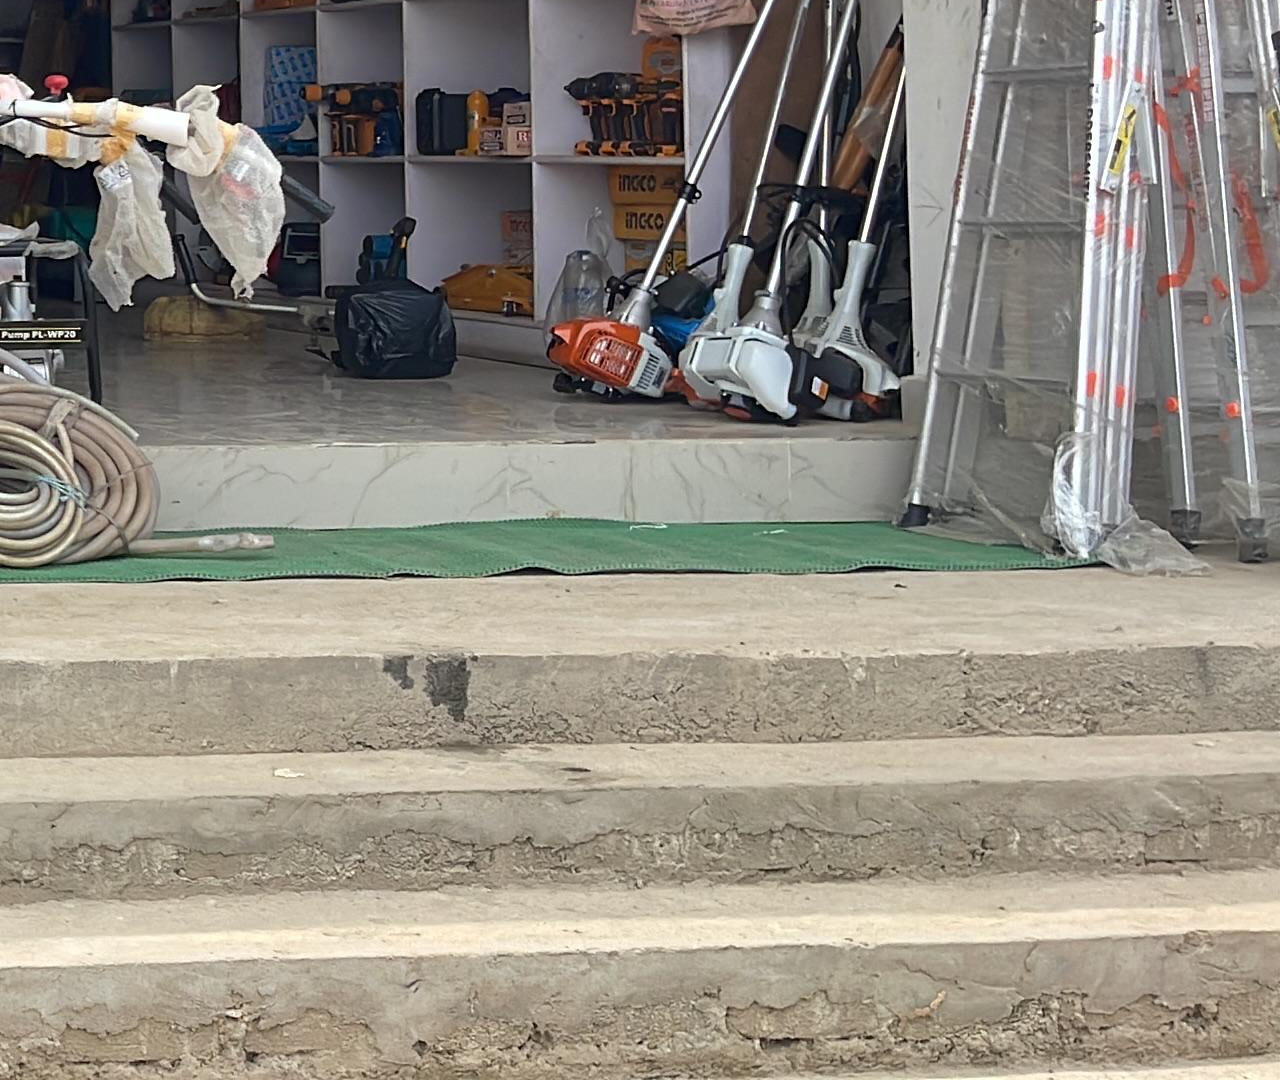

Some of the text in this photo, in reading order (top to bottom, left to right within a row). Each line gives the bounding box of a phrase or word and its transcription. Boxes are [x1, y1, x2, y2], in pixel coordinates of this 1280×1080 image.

[618, 174, 656, 192] INGCO
[625, 211, 664, 230] INGCO
[2, 331, 29, 341] Pump
[31, 331, 76, 339] PL-WP20
